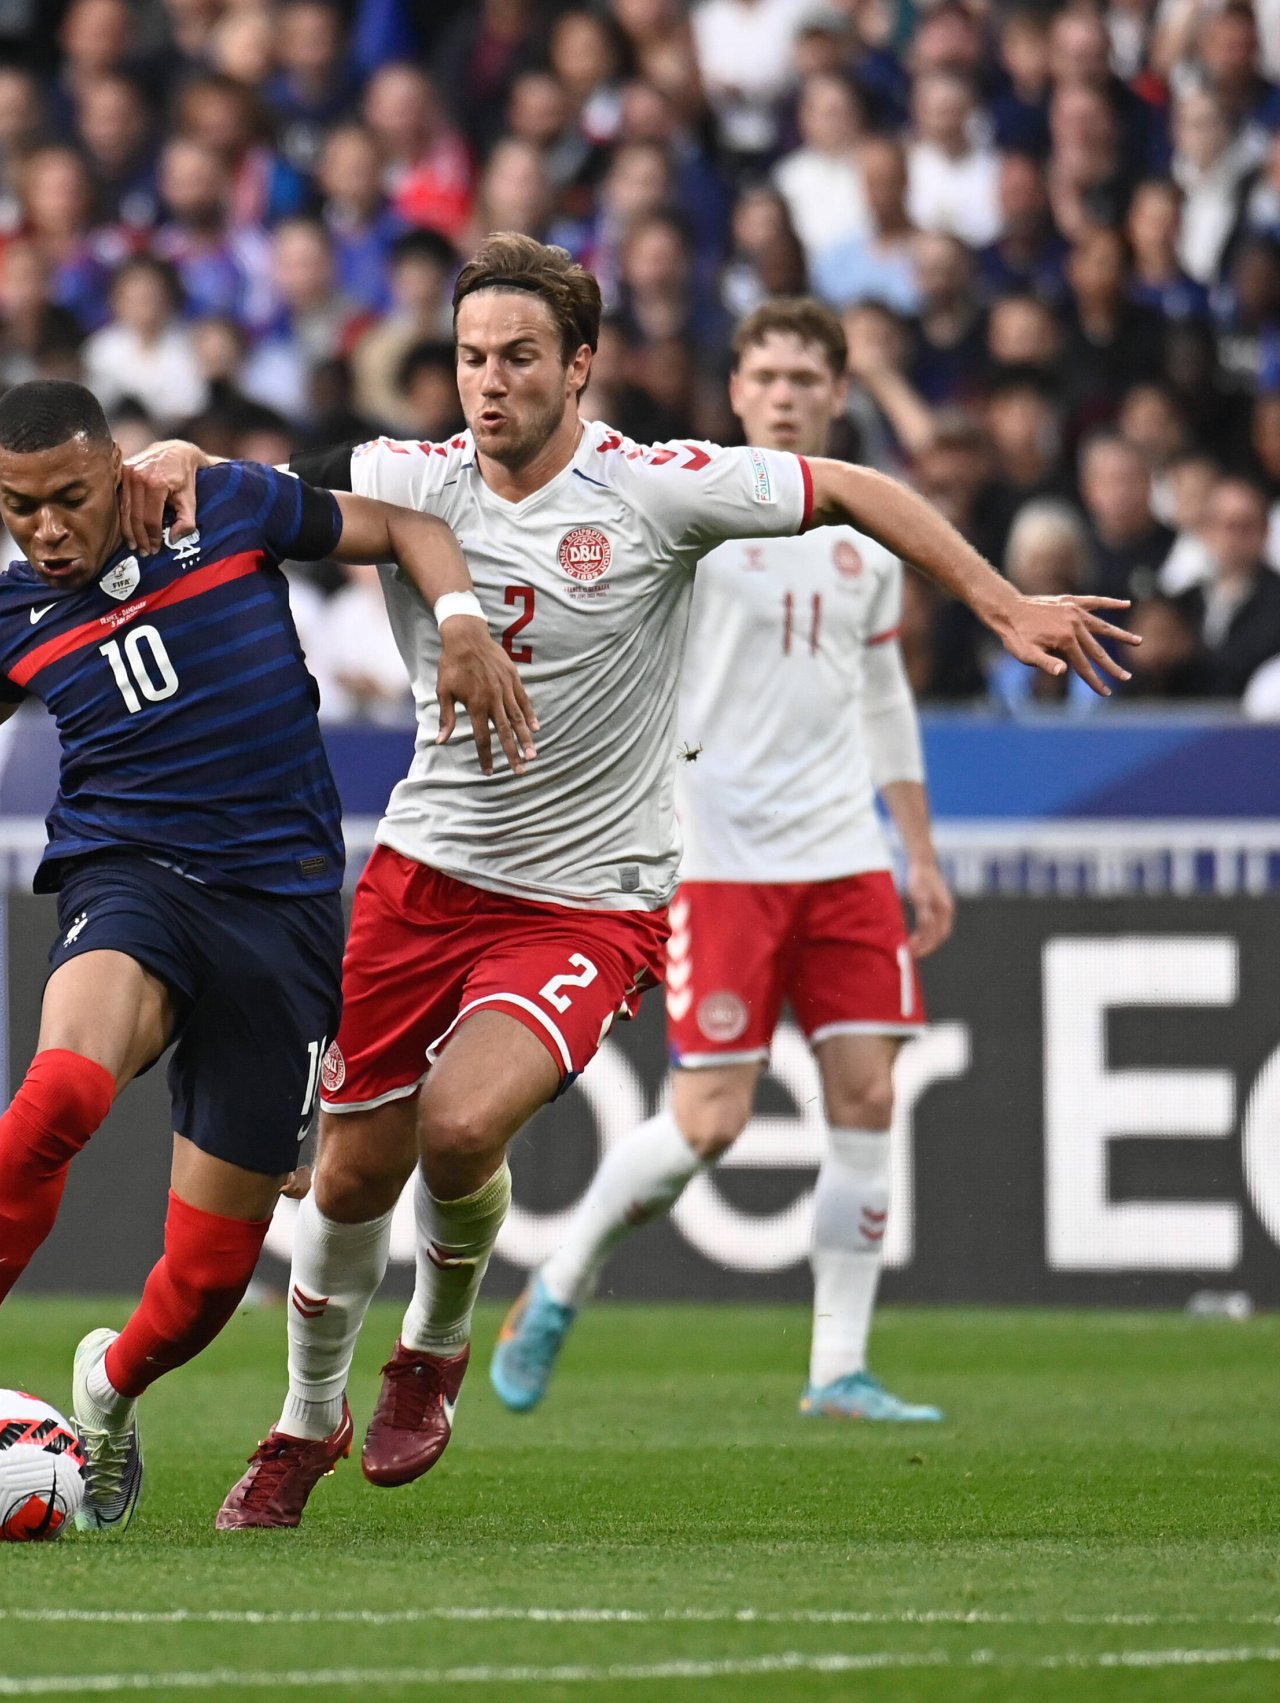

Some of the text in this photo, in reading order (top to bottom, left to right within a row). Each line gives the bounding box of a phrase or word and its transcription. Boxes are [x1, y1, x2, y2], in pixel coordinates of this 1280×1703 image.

[112, 579, 131, 589] FIFA
[570, 545, 601, 562] DBU
[502, 586, 534, 664] 2
[783, 591, 822, 657] 11
[98, 625, 179, 714] 10
[538, 953, 599, 1014] 2
[300, 1035, 327, 1116] 1
[1042, 934, 1280, 1273] E
